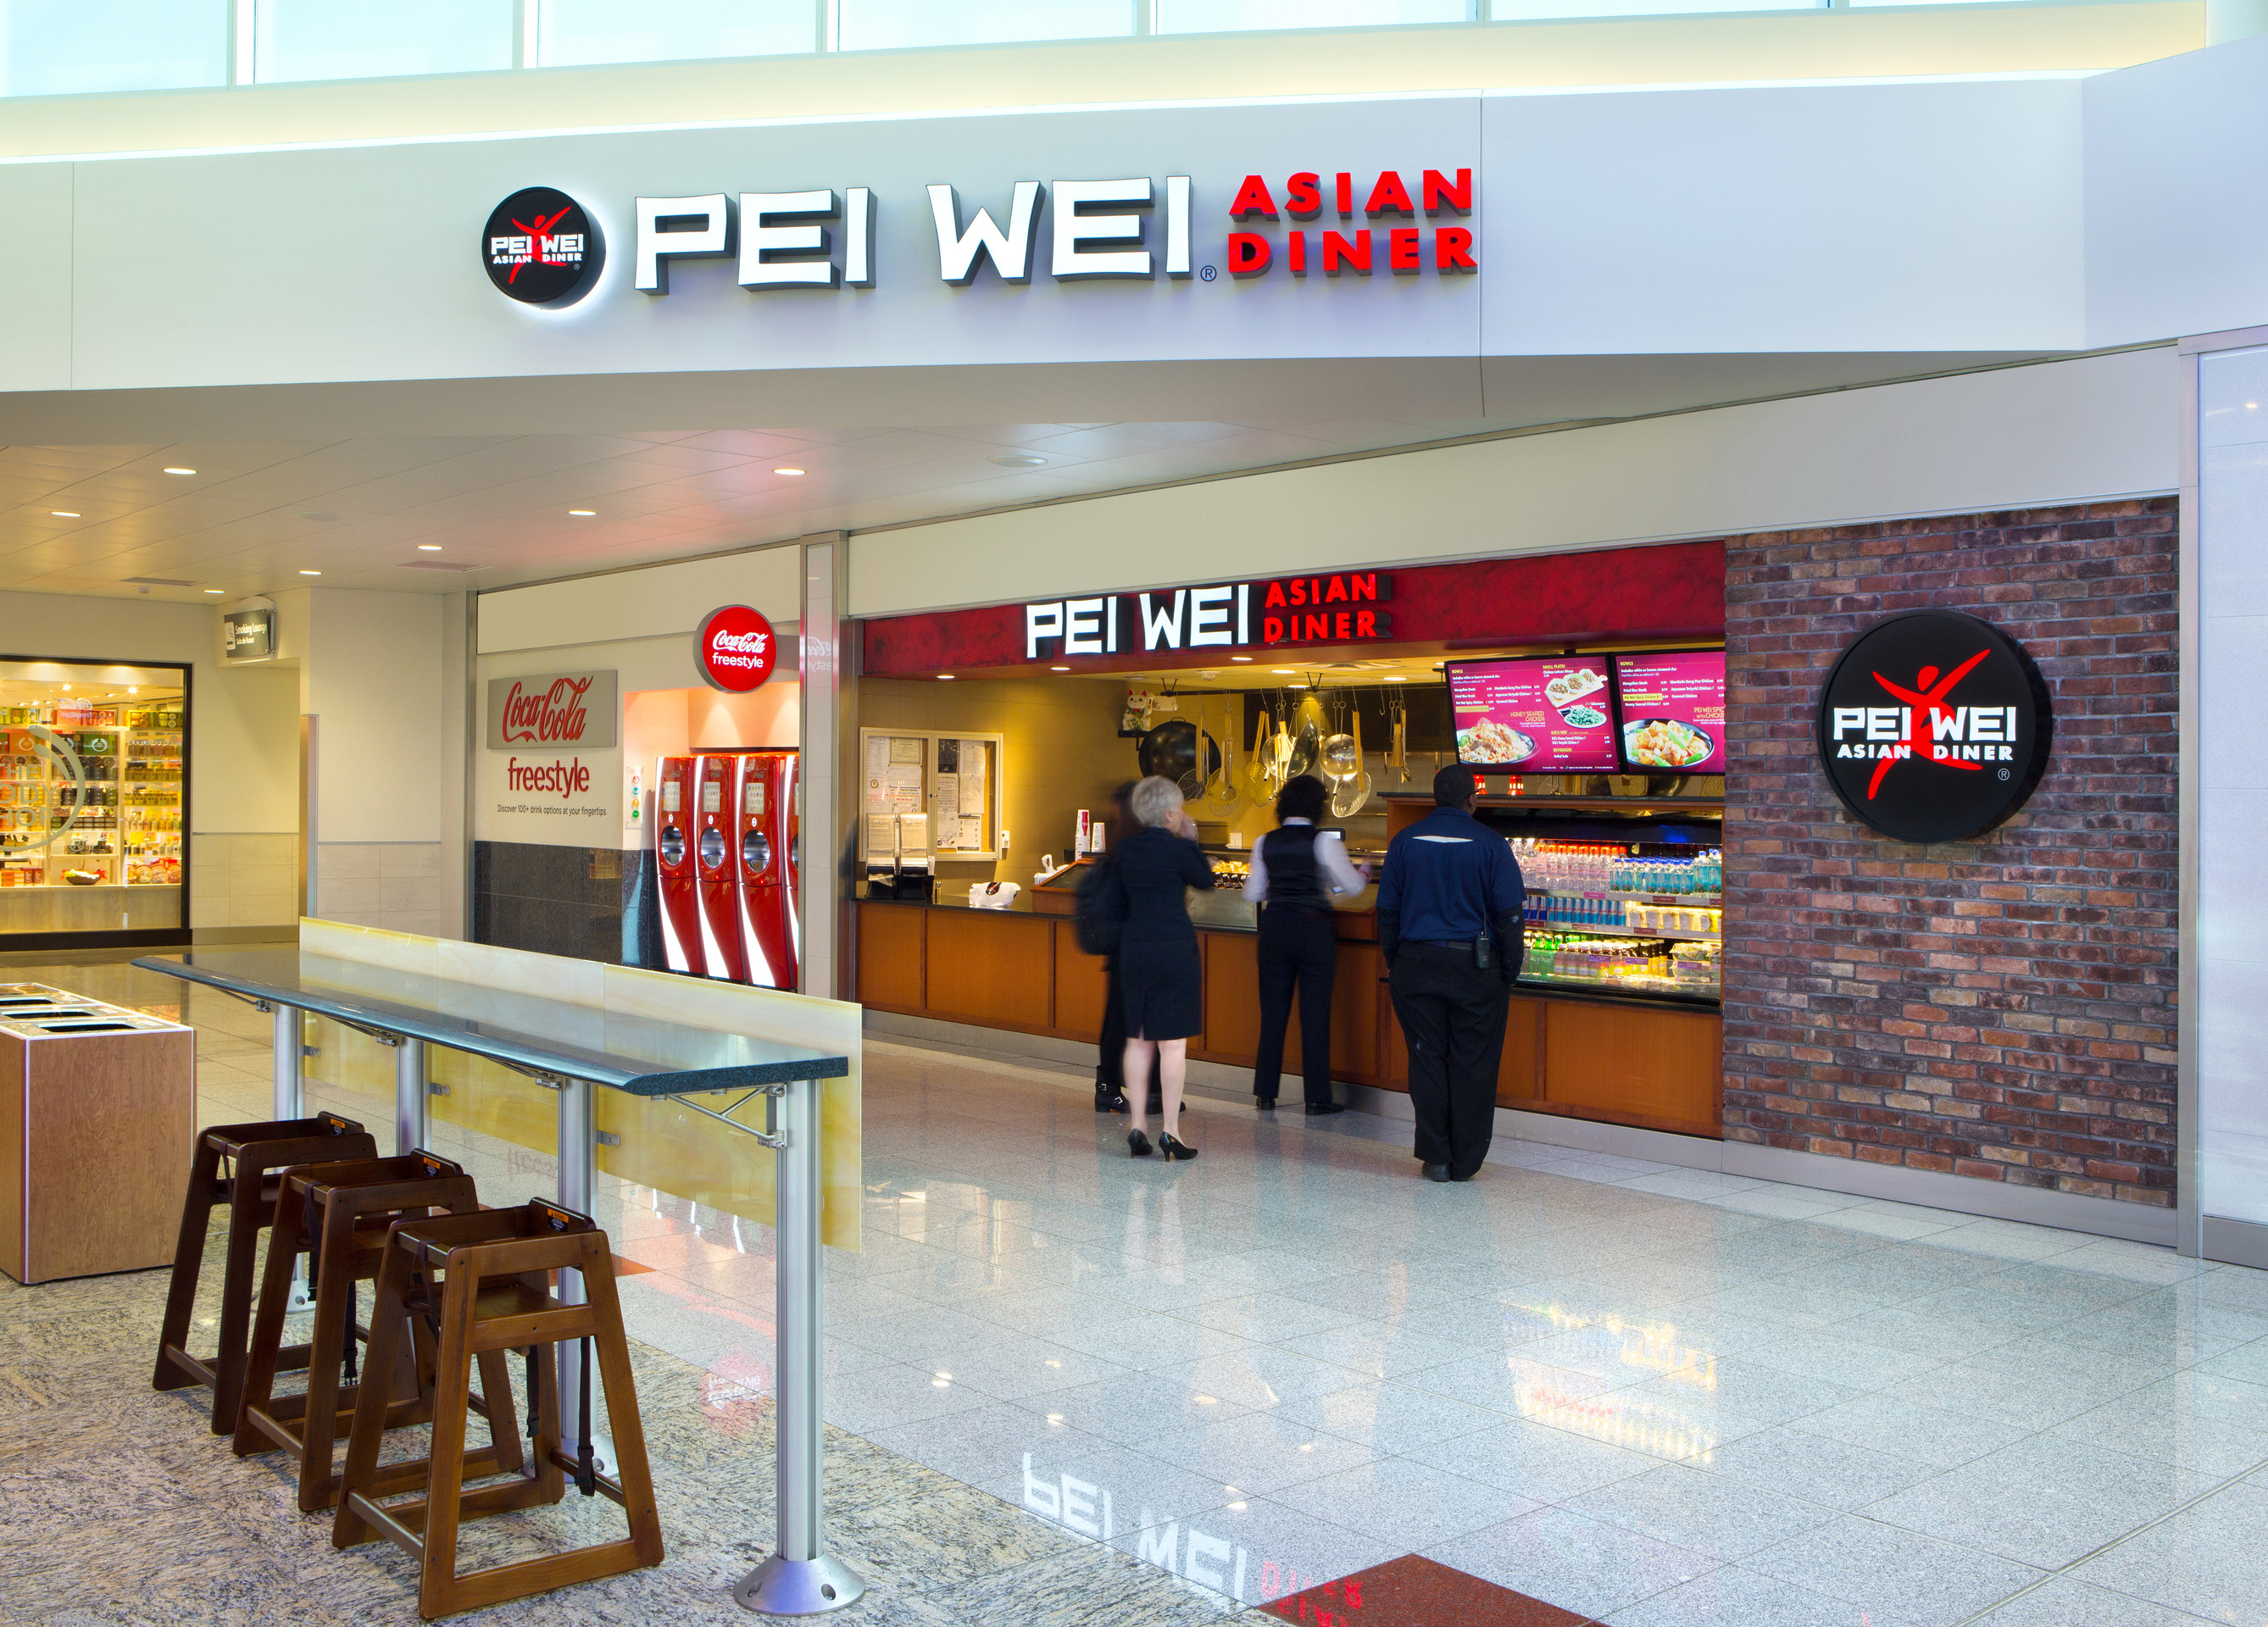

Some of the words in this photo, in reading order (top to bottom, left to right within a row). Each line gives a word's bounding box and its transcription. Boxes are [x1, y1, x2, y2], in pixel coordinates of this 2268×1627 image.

[1229, 168, 1472, 219] ASIAN
[491, 235, 532, 255] PEI
[541, 234, 584, 253] WEI
[634, 187, 873, 292] PEI
[926, 175, 1193, 281] WEI
[493, 255, 532, 264] ASIAN
[542, 253, 582, 262] DINER
[1228, 227, 1477, 275] DINER
[1265, 574, 1377, 608] ASIAN
[236, 624, 253, 636] Smoking
[253, 622, 268, 634] Lounge
[1026, 597, 1117, 658] PEI
[1139, 584, 1249, 651] WEI
[1265, 610, 1377, 643] DINER
[712, 630, 769, 653] Coca-Cola
[712, 652, 764, 669] freestyle
[502, 675, 593, 743] Coca-Cola
[1833, 707, 1911, 741] PEI
[1929, 707, 2016, 741] WEI
[1837, 744, 1911, 759] ASIAN
[1933, 746, 2014, 761] DINER
[508, 757, 590, 799] freestyle
[498, 803, 517, 813] Discover
[517, 805, 530, 814] 100+
[531, 805, 542, 814] drink
[543, 806, 562, 815] options
[569, 808, 581, 817] your
[581, 807, 607, 817] fingertips
